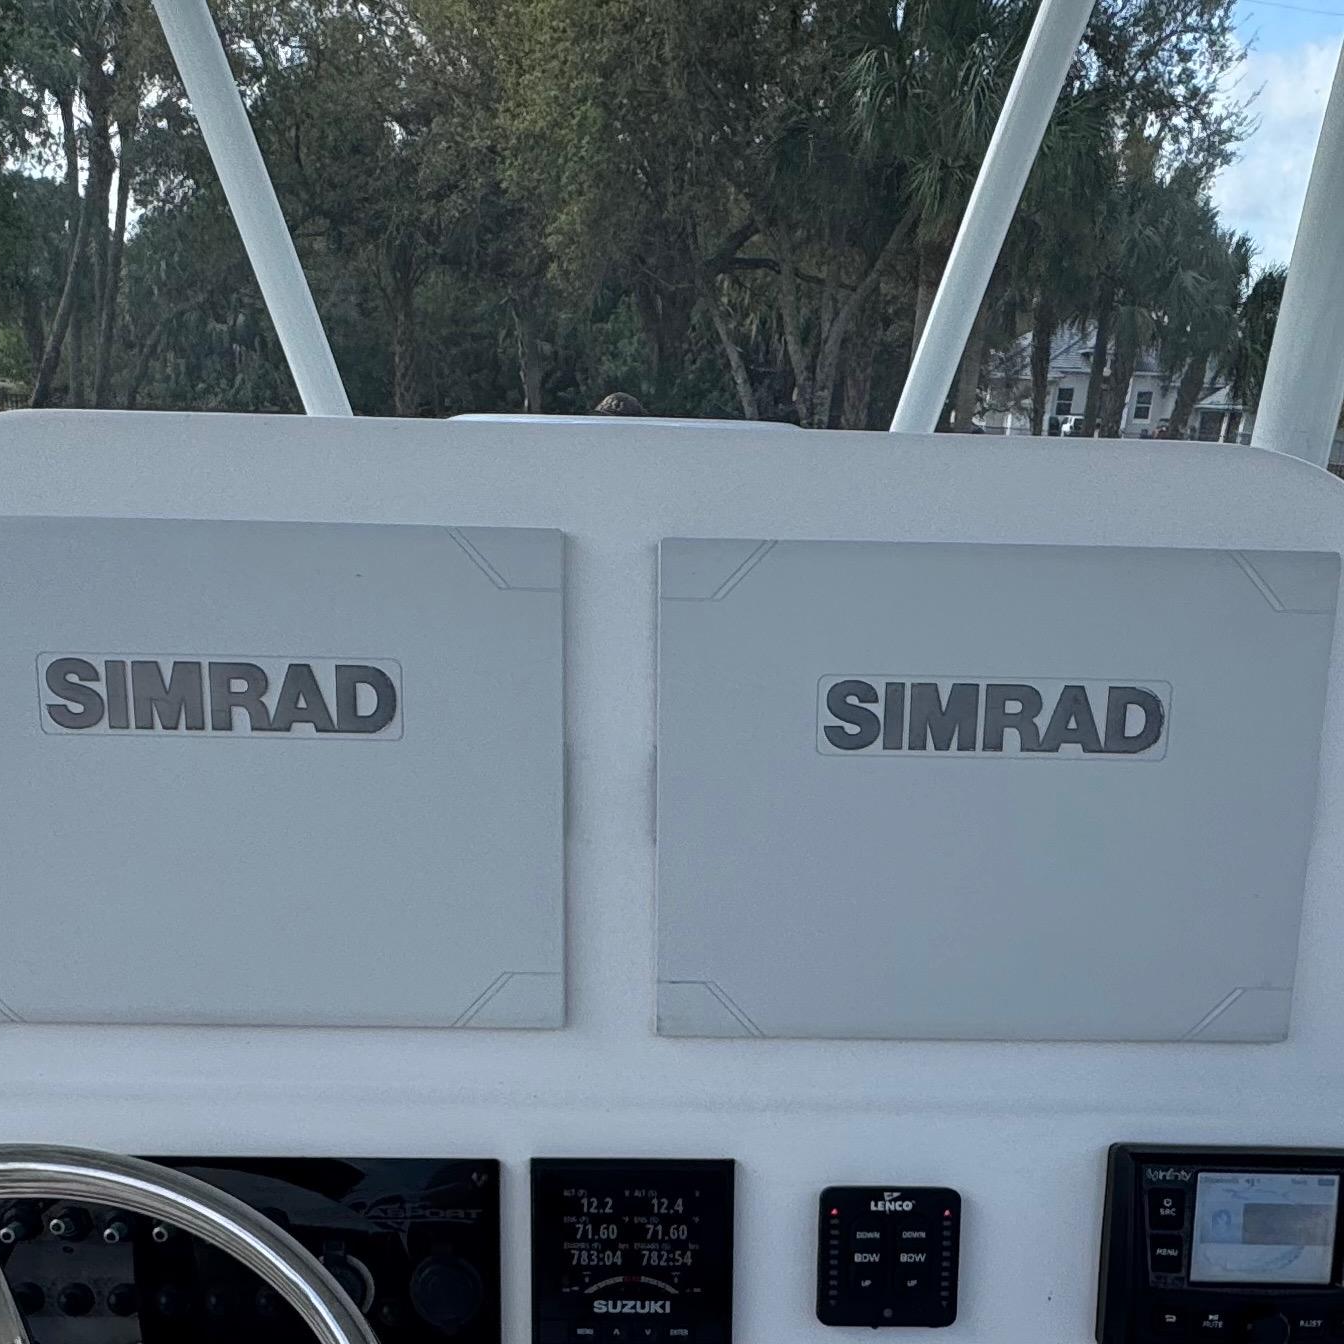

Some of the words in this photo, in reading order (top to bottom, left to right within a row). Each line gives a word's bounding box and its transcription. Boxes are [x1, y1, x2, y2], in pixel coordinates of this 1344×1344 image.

[45, 657, 397, 734] SIMRAD
[823, 679, 1166, 754] SIMRAD
[581, 1197, 614, 1213] 12.2
[651, 1198, 684, 1214] 12.4
[870, 1200, 914, 1212] LENCO
[575, 1223, 618, 1240] 71.60
[645, 1224, 688, 1240] 71.60
[570, 1250, 623, 1266] 783:04
[640, 1251, 693, 1266] 782:54
[853, 1252, 881, 1263] BOW
[899, 1252, 927, 1263] BOW
[593, 1300, 671, 1313] SUZUKI
